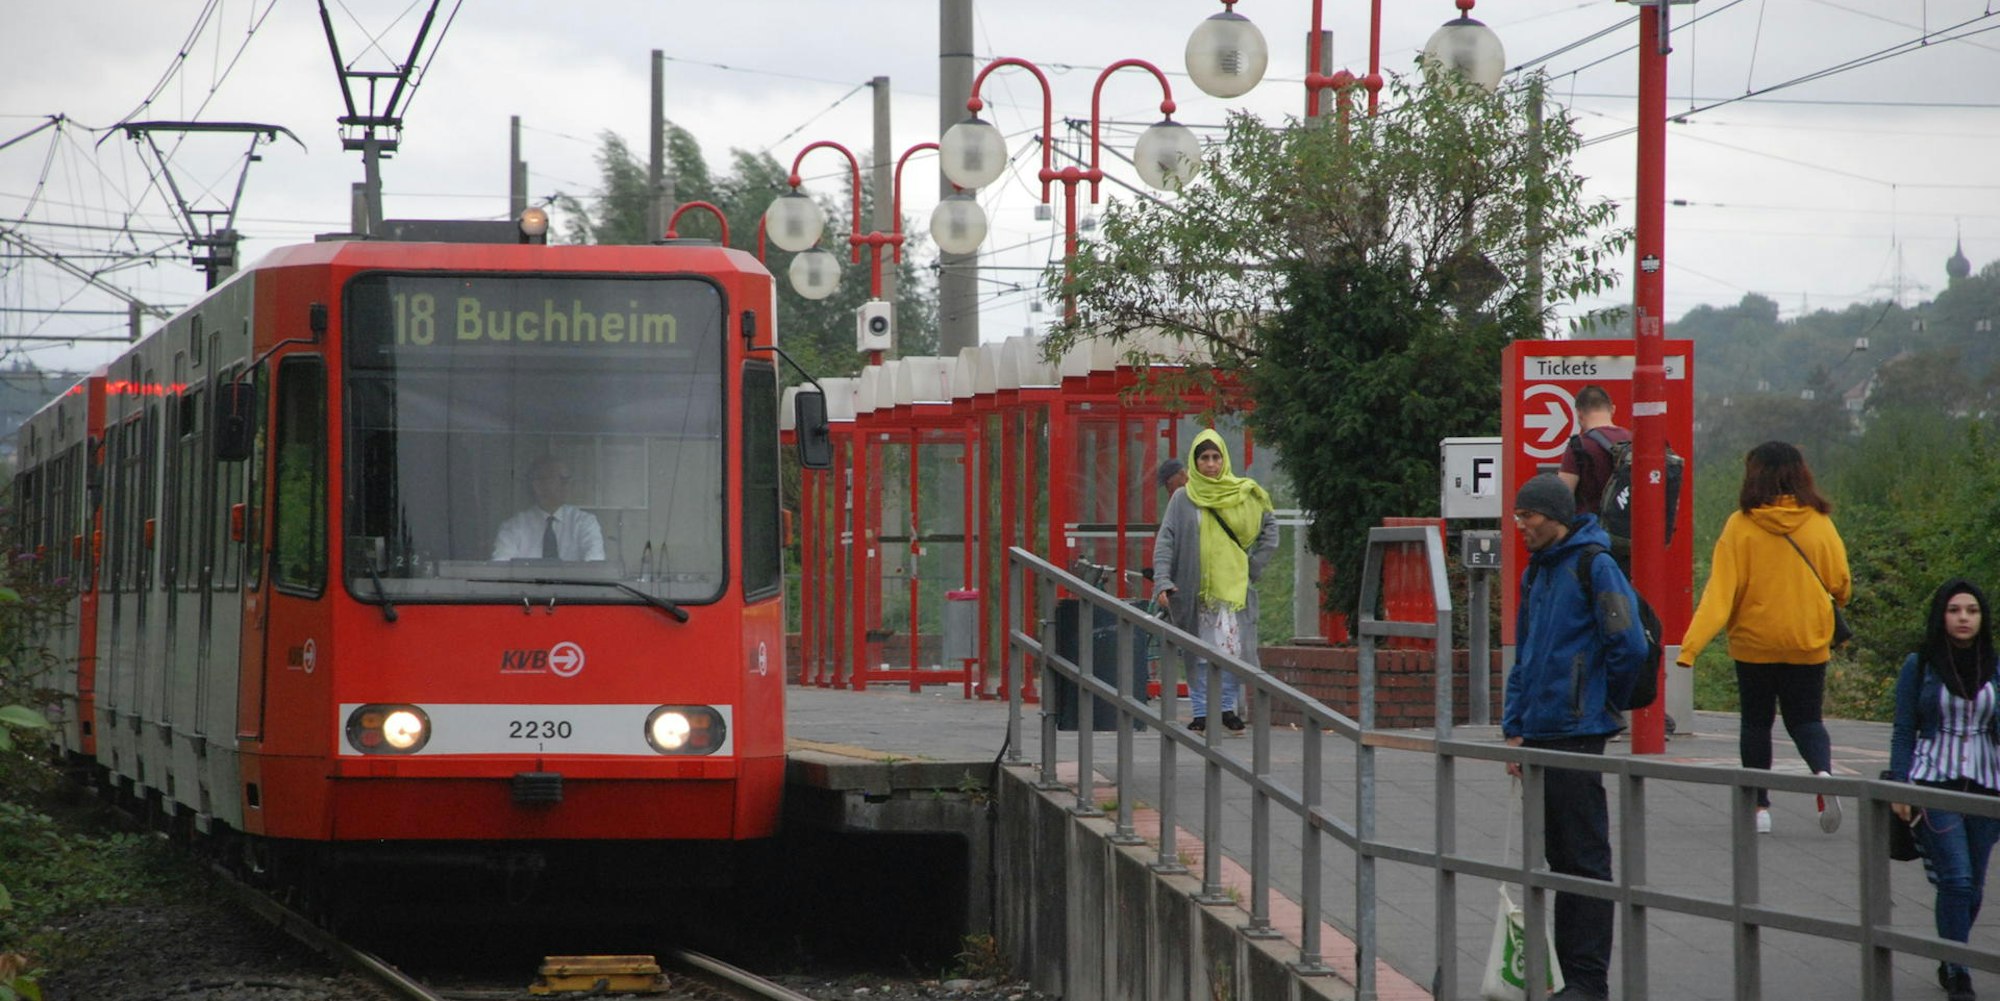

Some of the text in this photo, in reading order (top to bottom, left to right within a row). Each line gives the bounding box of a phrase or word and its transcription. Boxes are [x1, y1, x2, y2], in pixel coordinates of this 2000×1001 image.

[394, 294, 677, 345] 18 Buchheim
[1537, 360, 1597, 376] Tickets
[1473, 458, 1494, 494] F
[501, 649, 547, 670] KVB
[509, 720, 572, 739] 2230
